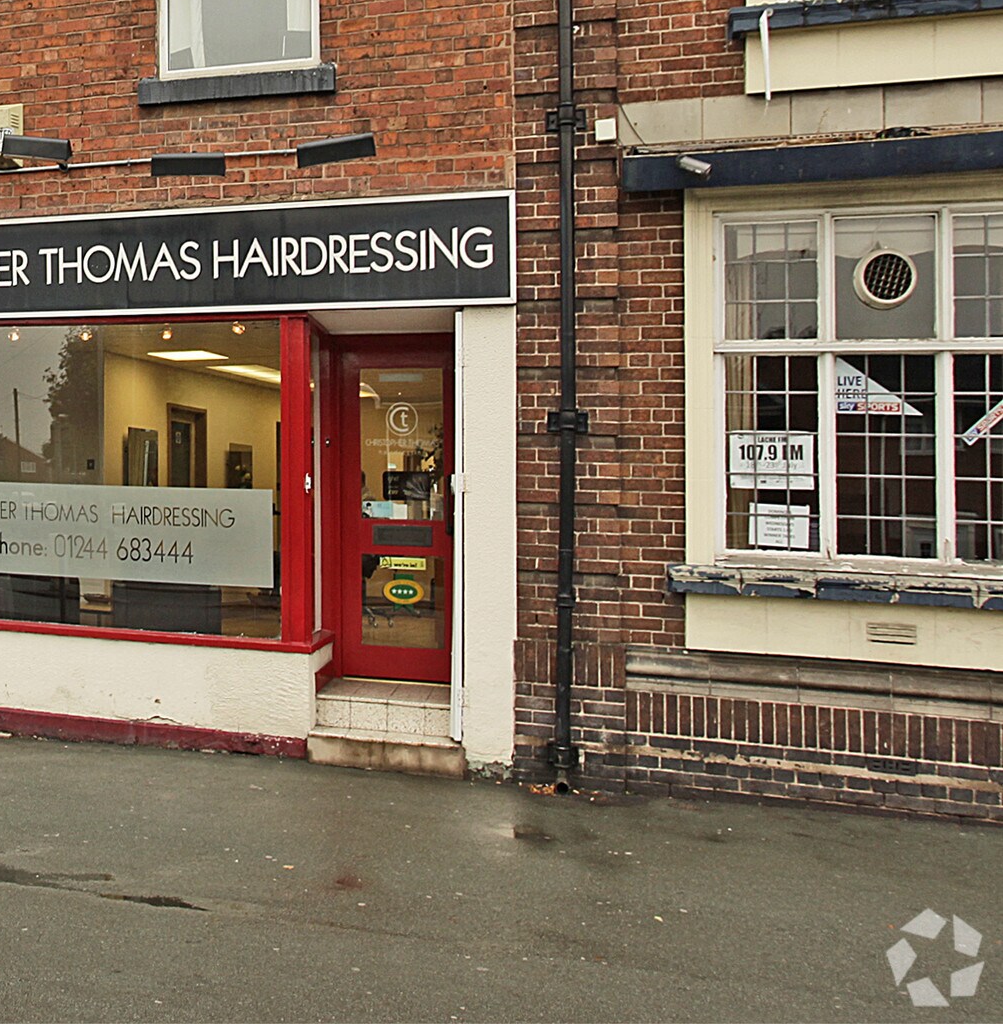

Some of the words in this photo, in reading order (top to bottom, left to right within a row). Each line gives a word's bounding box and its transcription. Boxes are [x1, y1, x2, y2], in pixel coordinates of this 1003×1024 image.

[38, 240, 202, 286] THOMAS
[212, 226, 495, 280] HAIRDRESSING
[837, 375, 862, 387] LIVE
[838, 402, 856, 412] sky
[857, 402, 899, 412] SPORTS
[739, 444, 778, 461] 107.9
[22, 502, 98, 524] THOMAS
[111, 505, 236, 529] HAIRDRESSING
[54, 534, 108, 560] 01244
[116, 537, 194, 565] 683444
